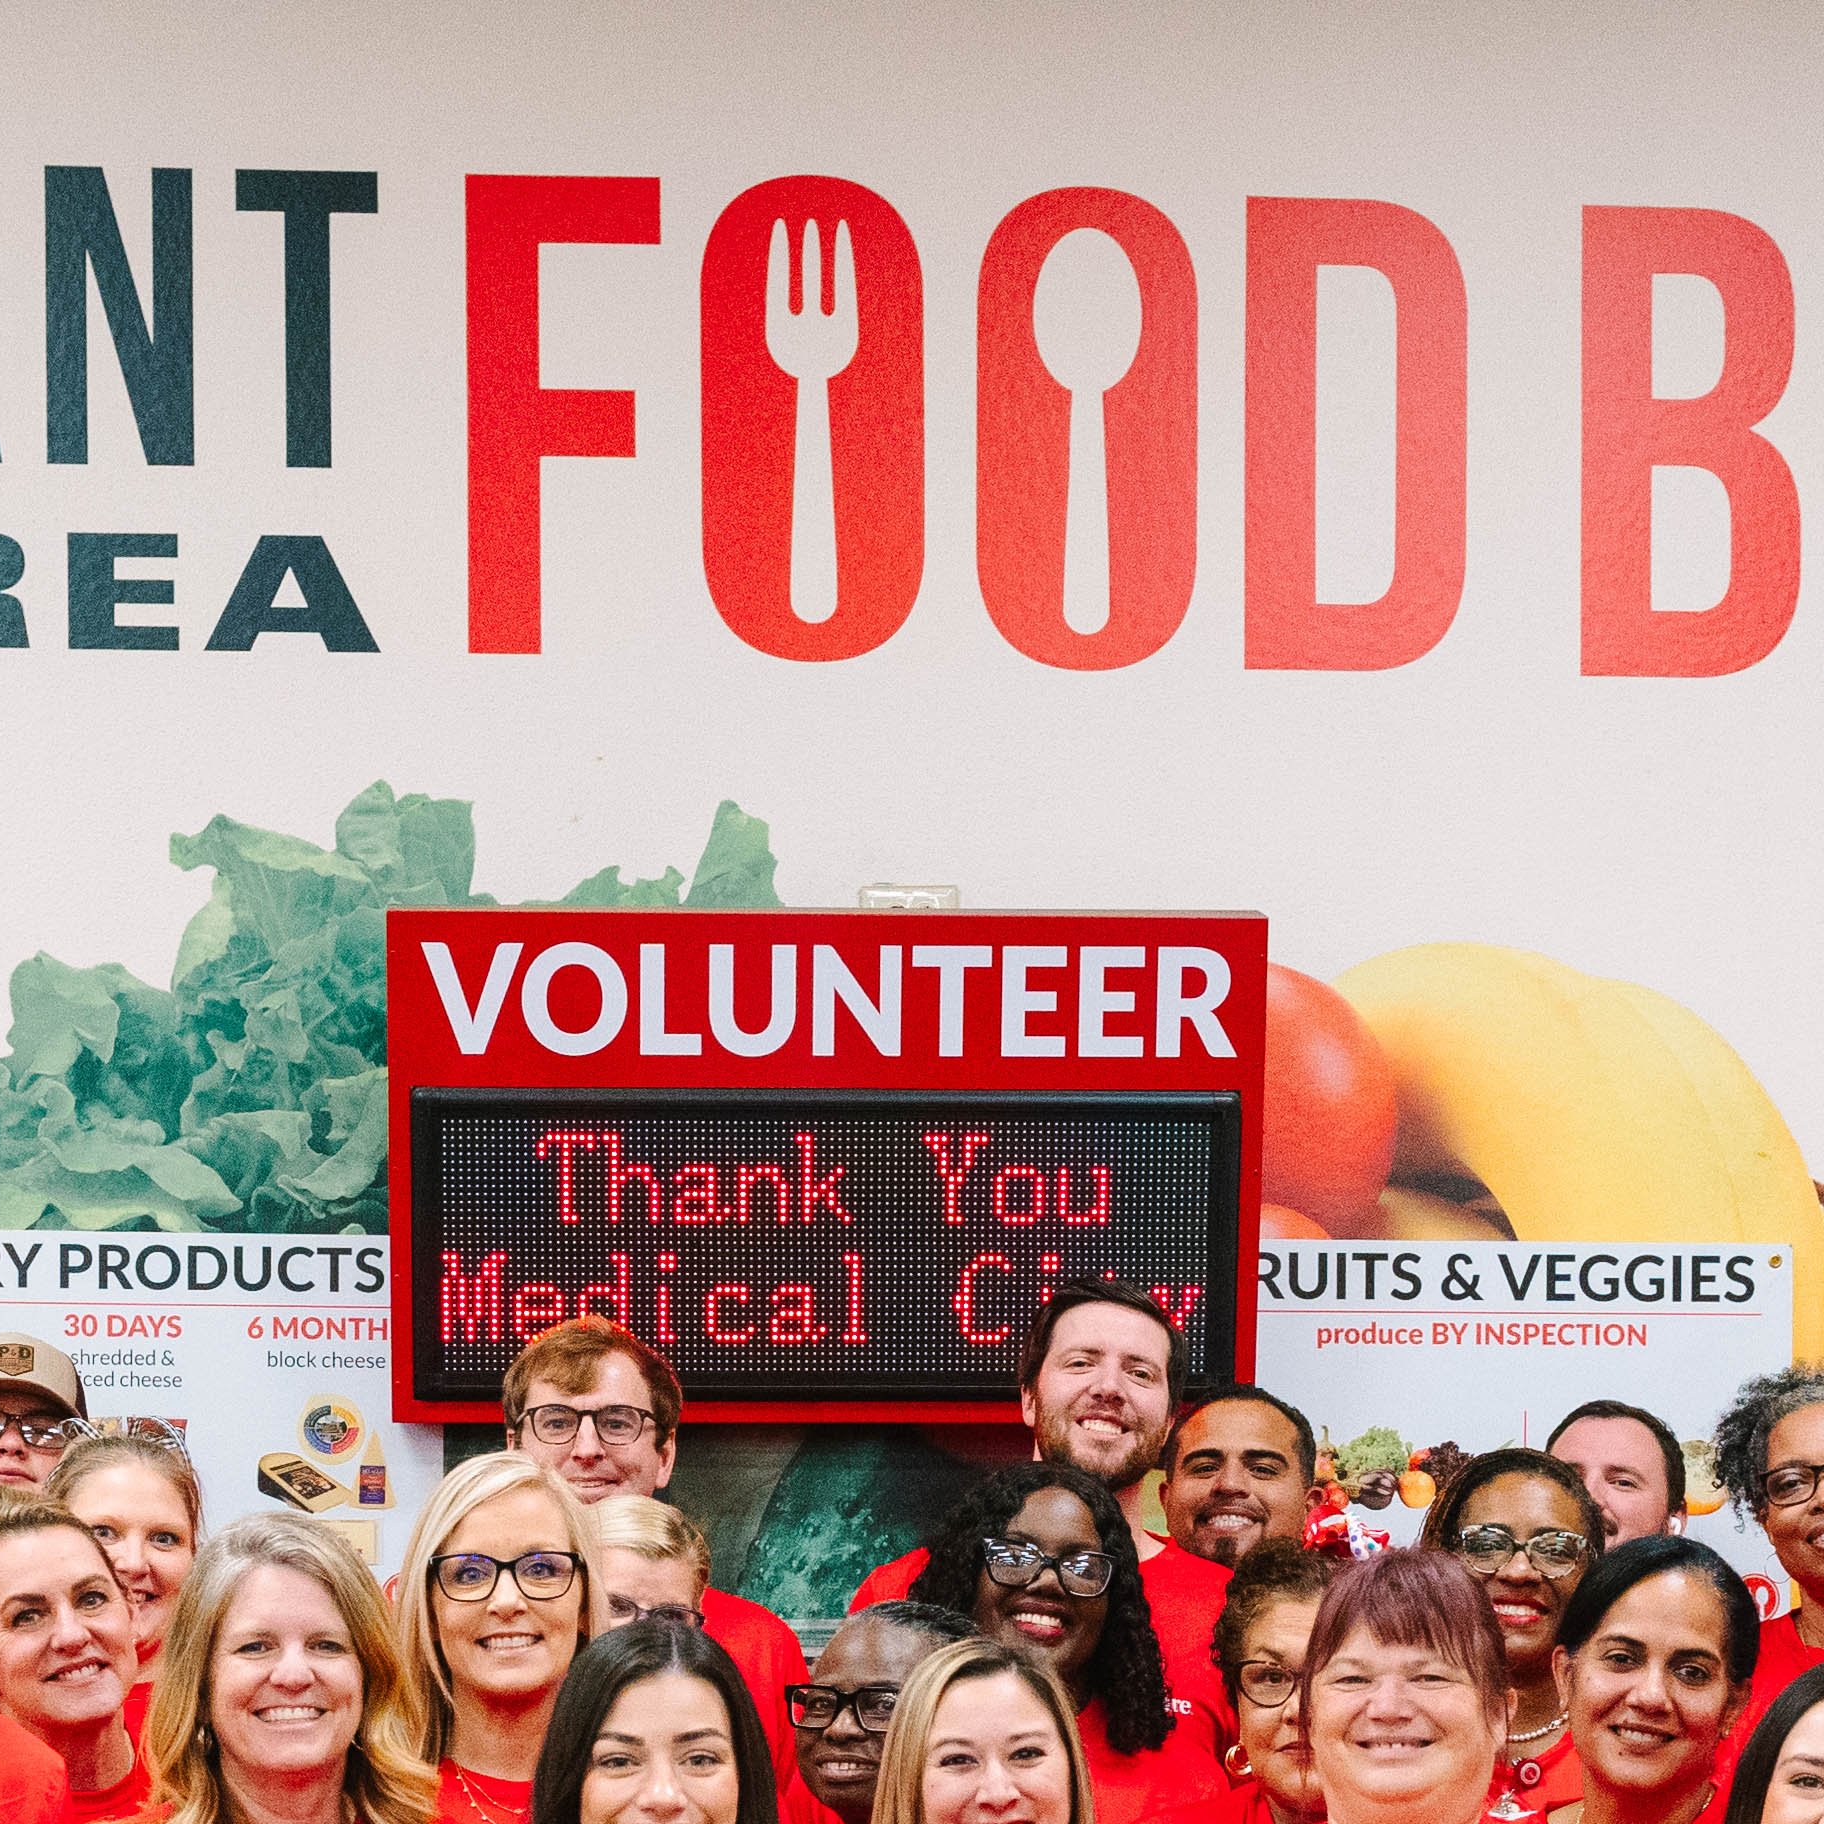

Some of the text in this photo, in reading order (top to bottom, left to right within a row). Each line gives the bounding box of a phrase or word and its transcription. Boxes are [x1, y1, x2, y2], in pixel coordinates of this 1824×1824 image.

[464, 173, 1469, 673] FOOD
[421, 941, 1236, 1059] VOLUNTEER
[536, 1132, 1112, 1225] Thank You
[60, 1244, 385, 1293] PRODUCTS
[1257, 1252, 1755, 1303] RUITS & VEGGIES
[440, 1252, 866, 1344] Medical
[64, 1314, 182, 1338] 30 DAYS
[247, 1316, 389, 1341] 6 MONTH
[1316, 1322, 1647, 1348] produce BY INSPECTION
[71, 1350, 175, 1366] shredded &
[267, 1351, 386, 1369] block cheese
[78, 1372, 183, 1388] iced cheese
